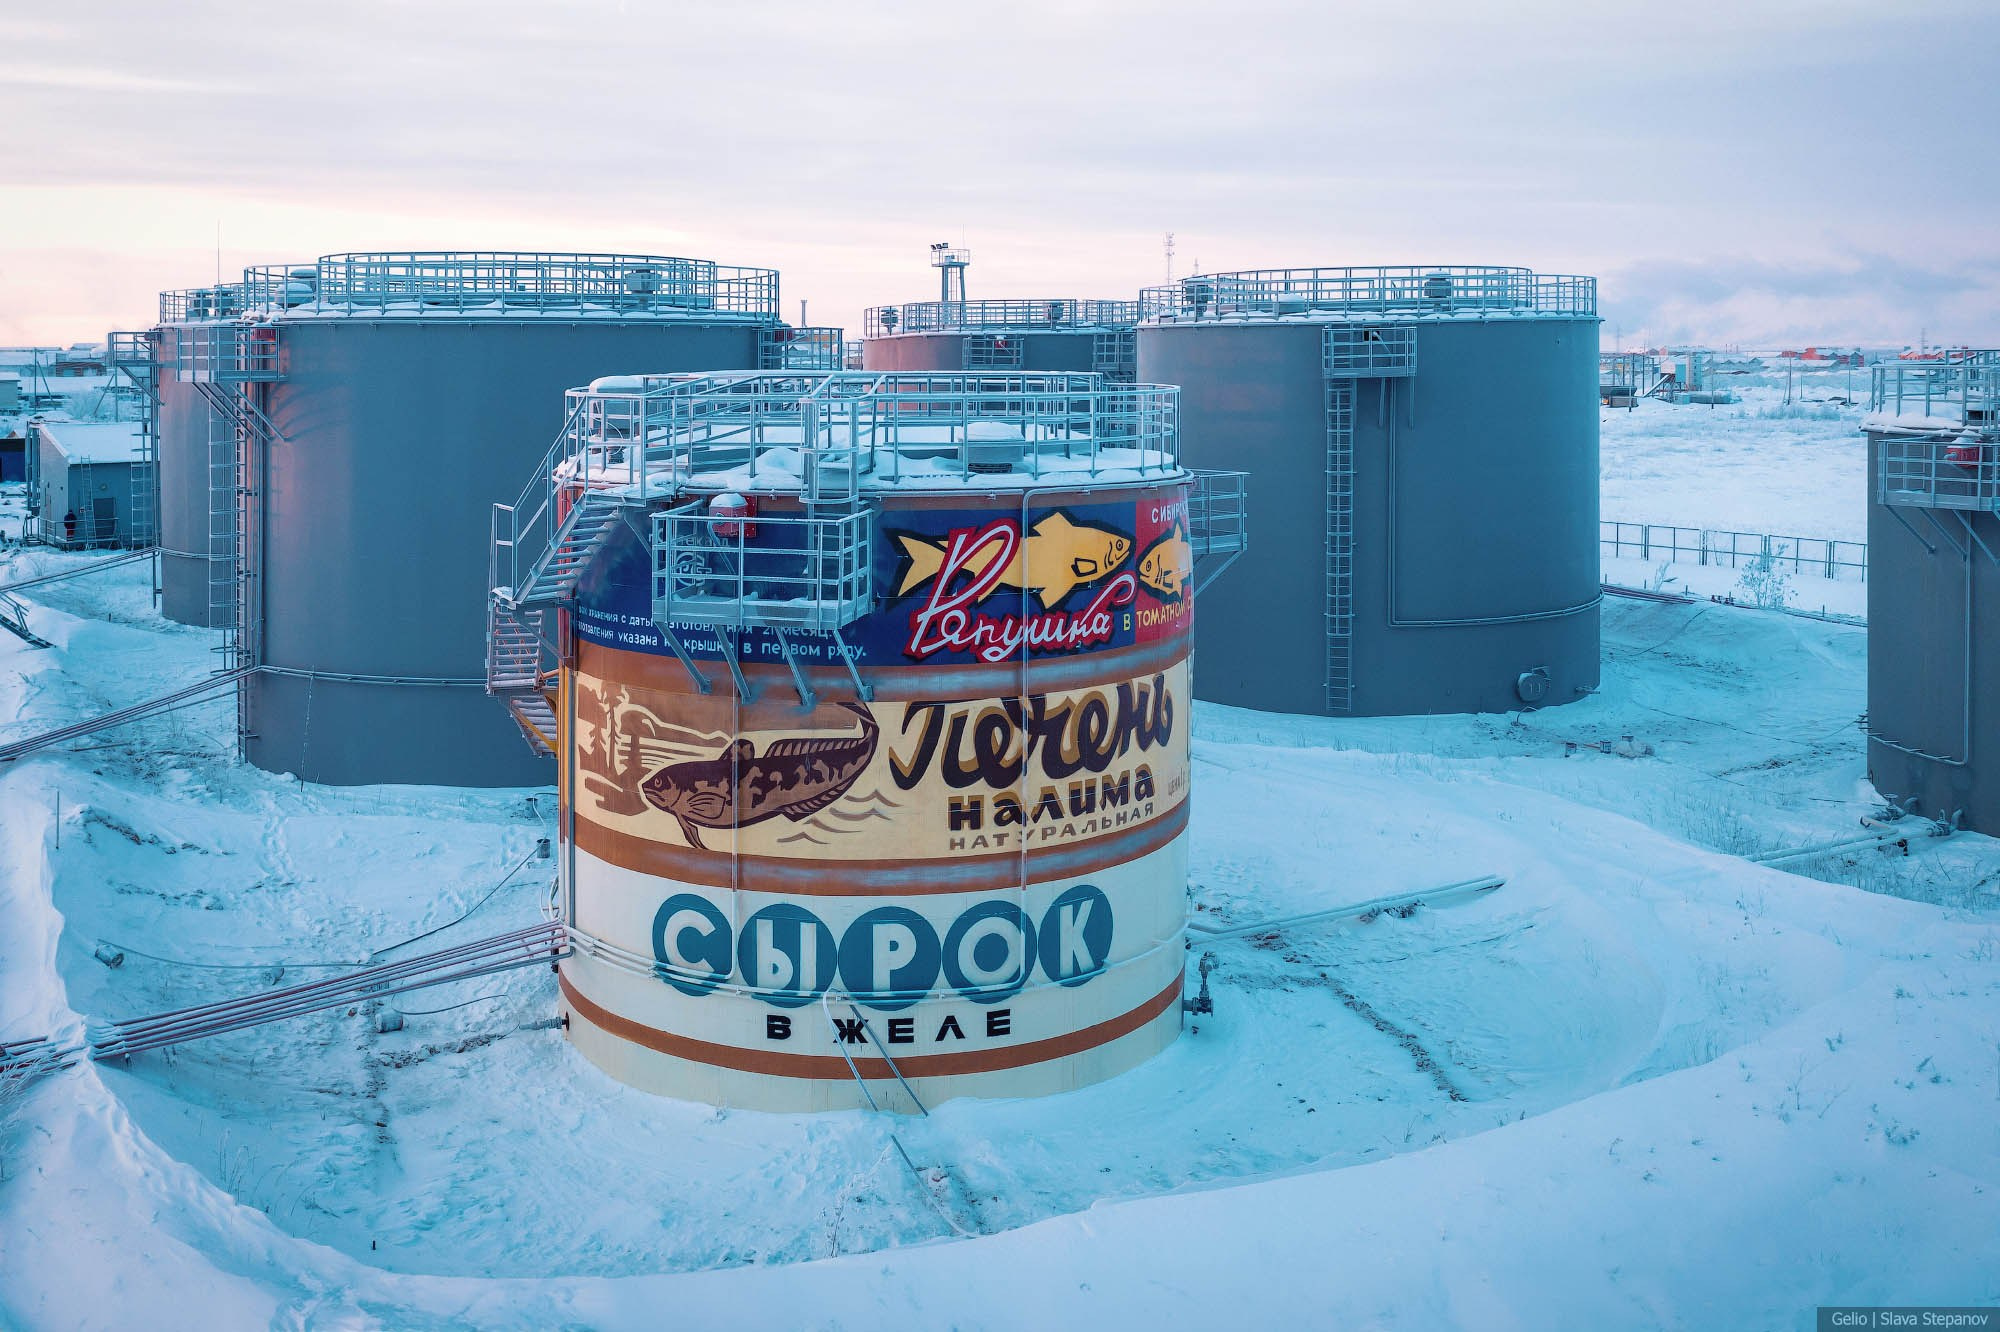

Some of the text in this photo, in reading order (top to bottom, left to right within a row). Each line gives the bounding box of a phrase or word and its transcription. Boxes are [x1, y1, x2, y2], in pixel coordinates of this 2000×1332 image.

[629, 616, 653, 628] даты
[1123, 613, 1131, 632] В
[1136, 602, 1184, 629] ТОМАТНОМ
[618, 632, 658, 646] указана
[743, 642, 752, 654] в
[888, 671, 1174, 791] Печень
[949, 801, 1154, 851] НАТУРАЛЬНАЯ
[663, 899, 1094, 991] СЫРОК
[765, 1008, 1012, 1044] В ЖЕЛЕ
